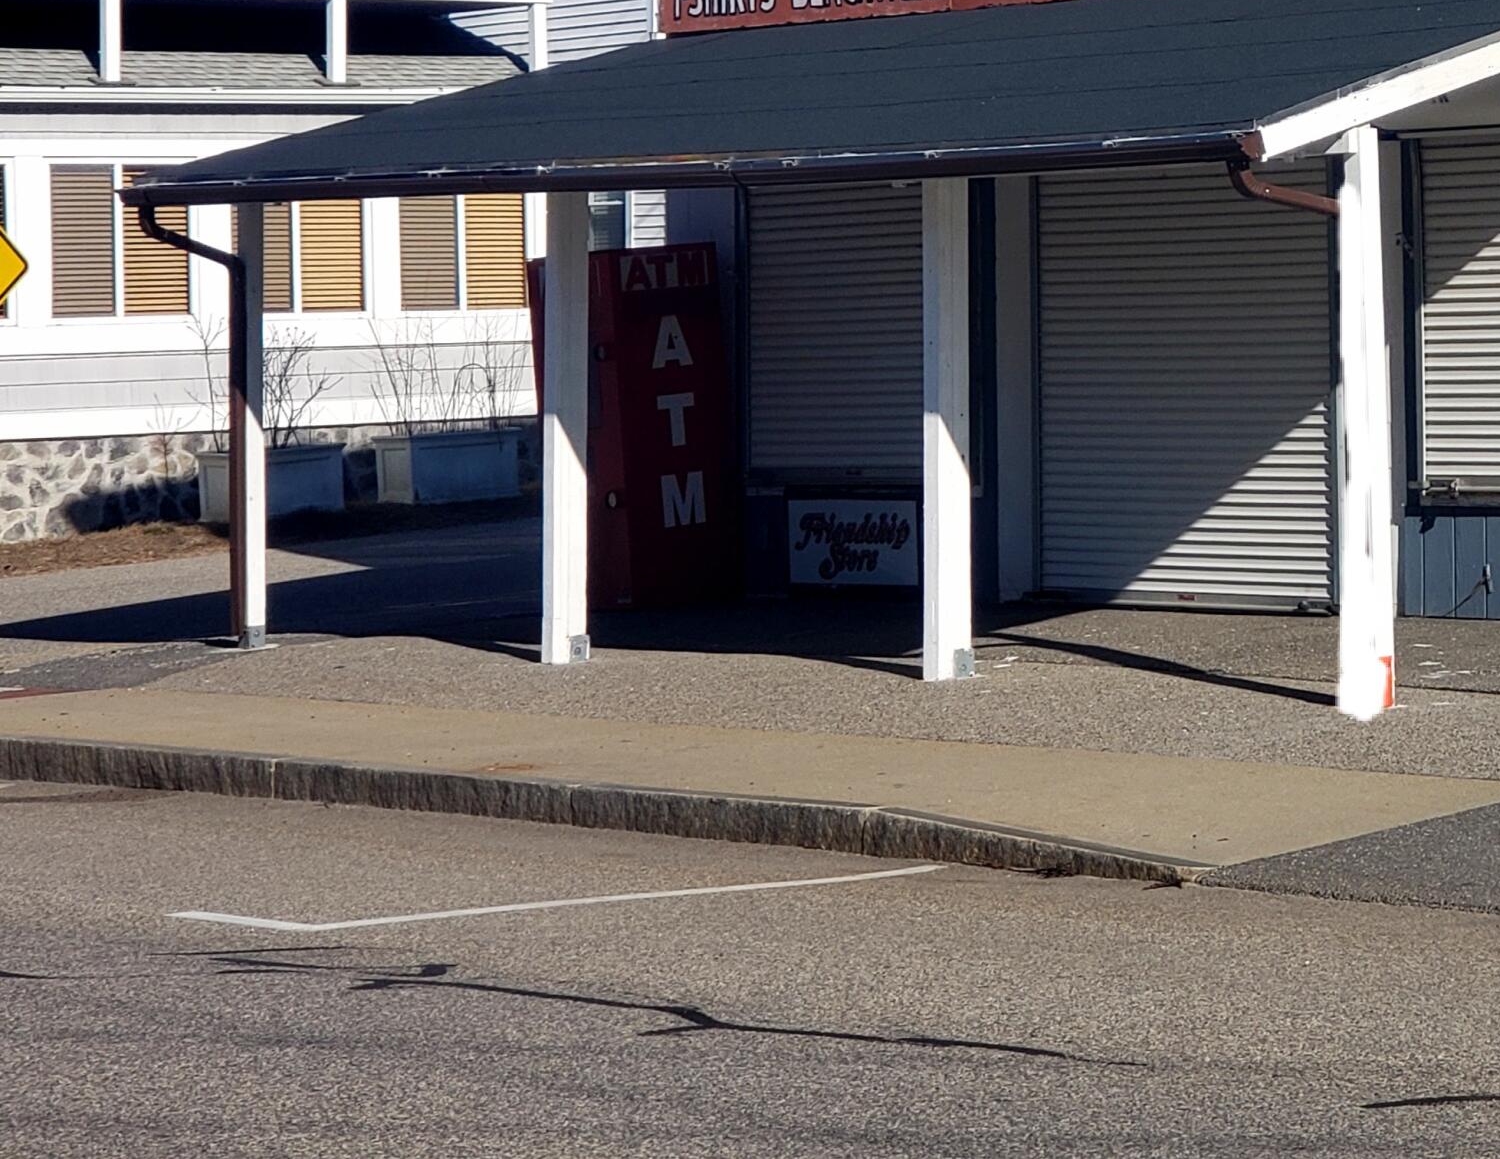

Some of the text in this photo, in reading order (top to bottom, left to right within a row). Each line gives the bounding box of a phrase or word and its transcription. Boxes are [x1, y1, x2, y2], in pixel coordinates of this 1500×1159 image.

[624, 251, 707, 291] ATM
[652, 314, 707, 528] ATM
[794, 512, 910, 550] Friendship
[818, 544, 880, 580] Store
